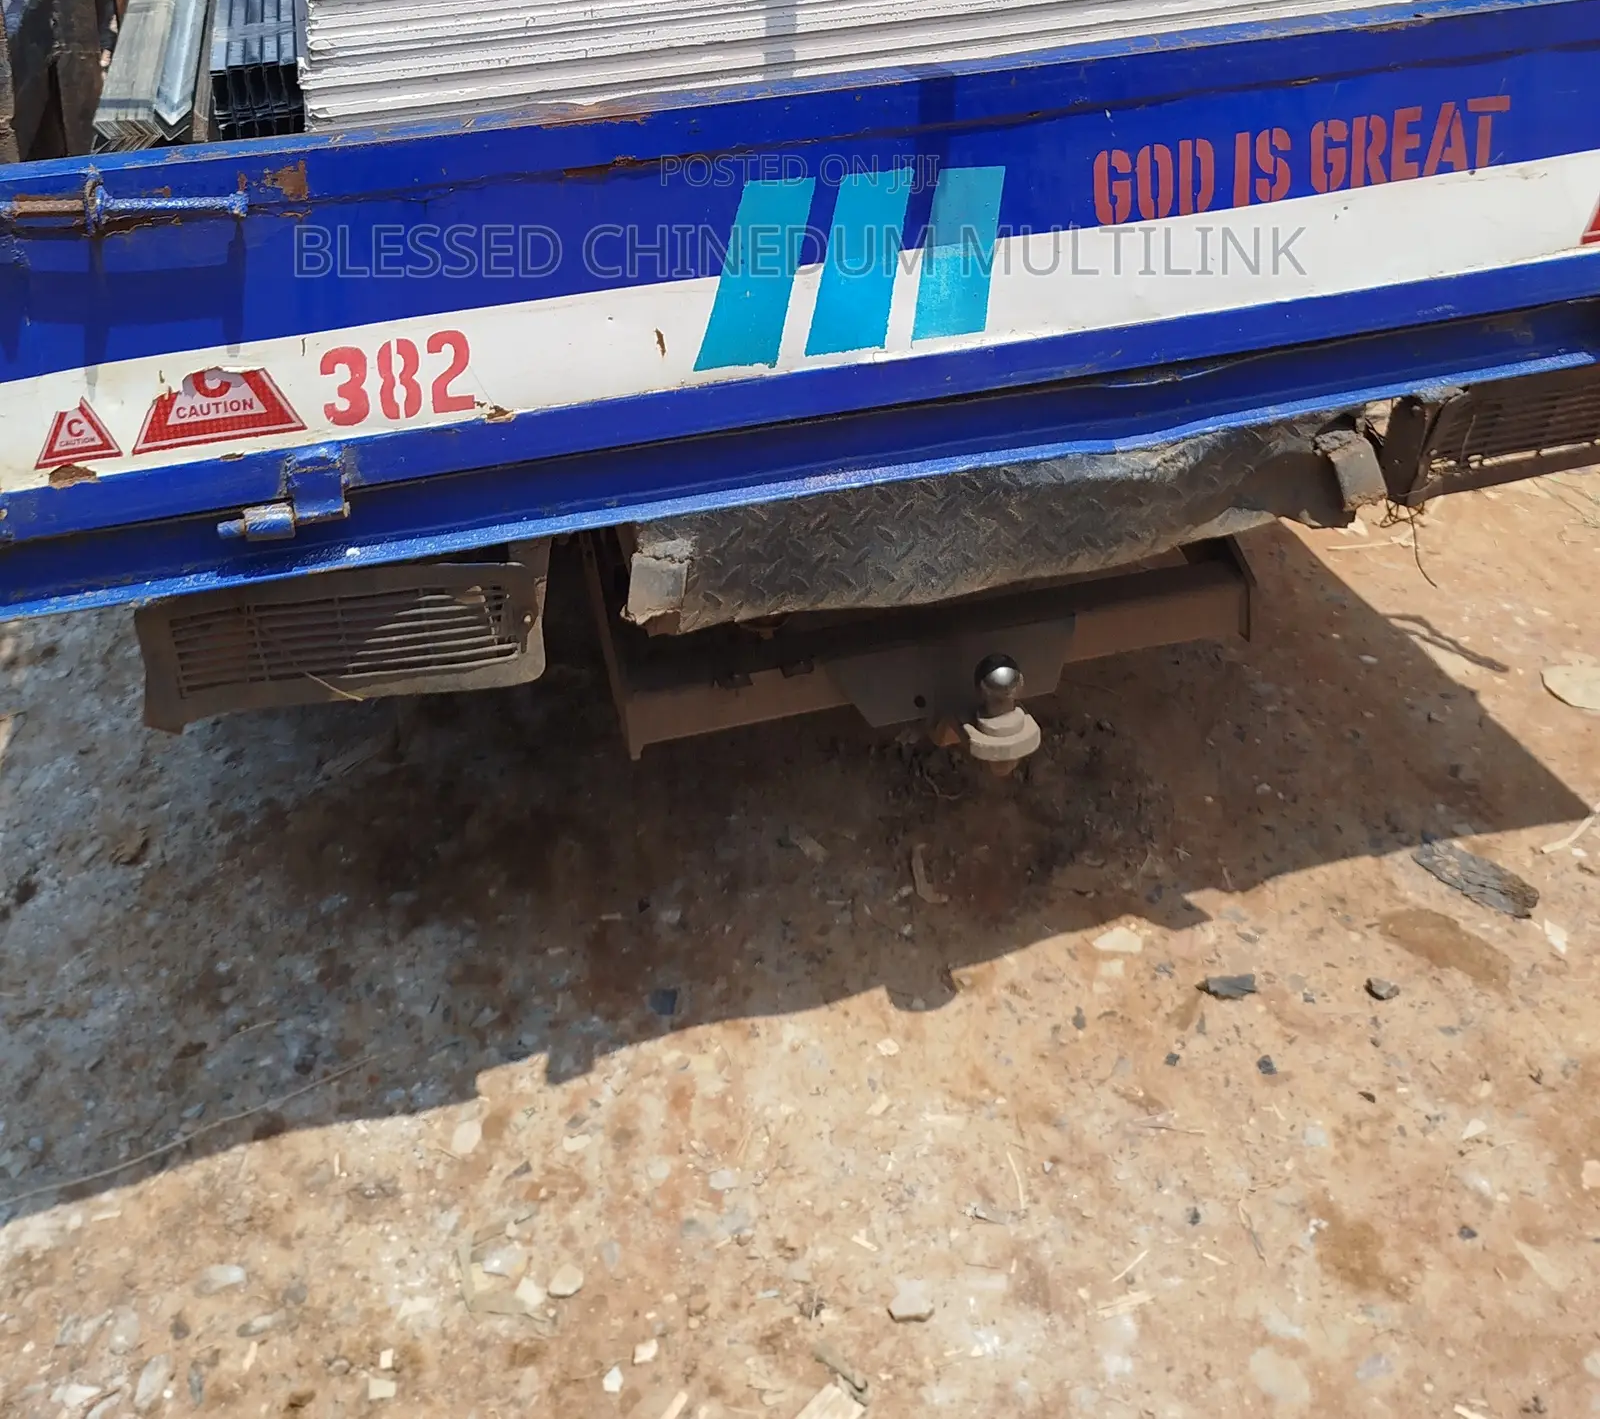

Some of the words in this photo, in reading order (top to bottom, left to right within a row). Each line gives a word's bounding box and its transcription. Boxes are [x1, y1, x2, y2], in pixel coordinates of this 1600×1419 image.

[1093, 138, 1215, 226] GOD
[1233, 128, 1291, 208] IS
[1310, 94, 1511, 194] GREAT
[320, 329, 476, 427] 382
[175, 397, 257, 420] CAUTION
[66, 417, 87, 439] C
[58, 436, 97, 449] CAUTION
